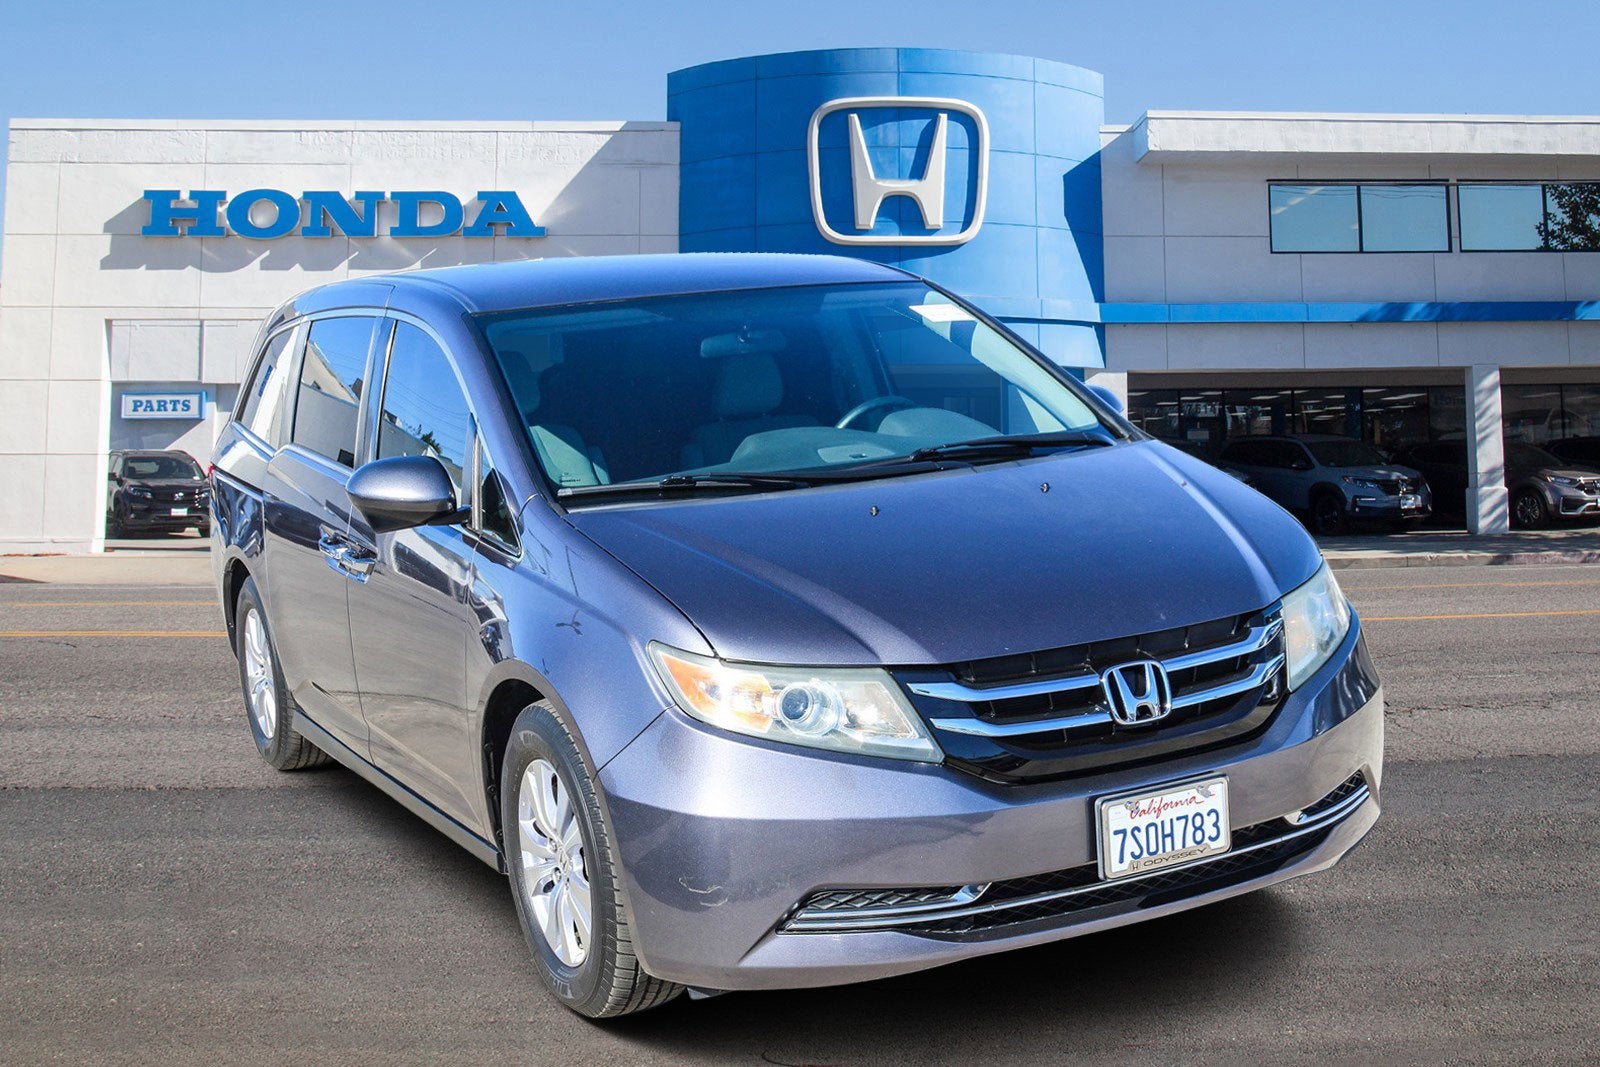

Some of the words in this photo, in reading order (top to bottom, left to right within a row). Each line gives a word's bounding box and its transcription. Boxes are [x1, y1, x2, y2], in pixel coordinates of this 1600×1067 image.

[141, 189, 547, 240] HONDA
[131, 399, 191, 413] PARTS
[1130, 794, 1215, 819] California
[1113, 808, 1221, 864] 7SOH783
[1143, 847, 1207, 867] ODYSSEY
